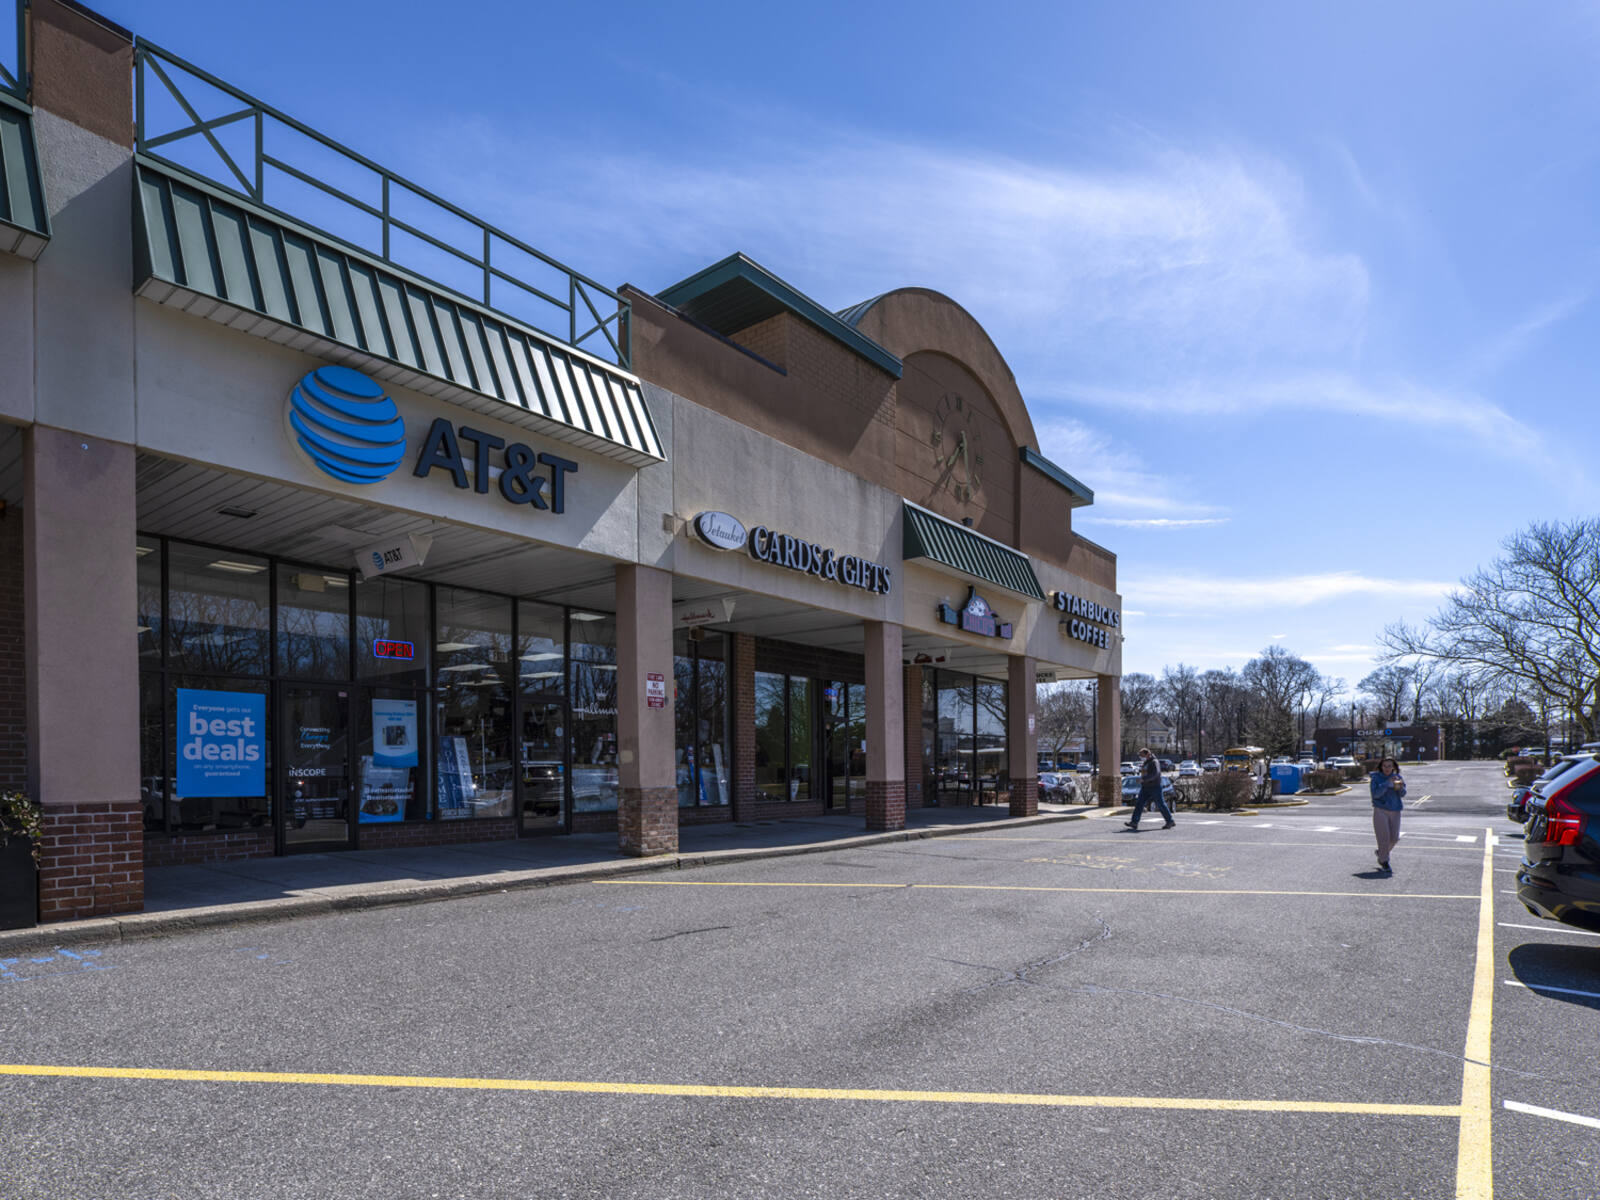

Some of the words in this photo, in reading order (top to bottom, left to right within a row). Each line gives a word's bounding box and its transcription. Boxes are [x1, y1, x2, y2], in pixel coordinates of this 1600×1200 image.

[413, 417, 578, 515] AT&T
[701, 512, 745, 544] Setauket
[384, 547, 402, 564] AT&T
[751, 525, 822, 575] CARDS
[824, 547, 839, 581] &
[842, 554, 892, 595] GIFTS
[1056, 591, 1120, 628] STARBUCKS
[1069, 618, 1111, 649] COFFEE
[376, 641, 413, 658] OPEN
[193, 704, 225, 712] Everyone
[572, 698, 618, 720] Hallmar
[189, 711, 256, 737] best
[183, 736, 260, 762] deals
